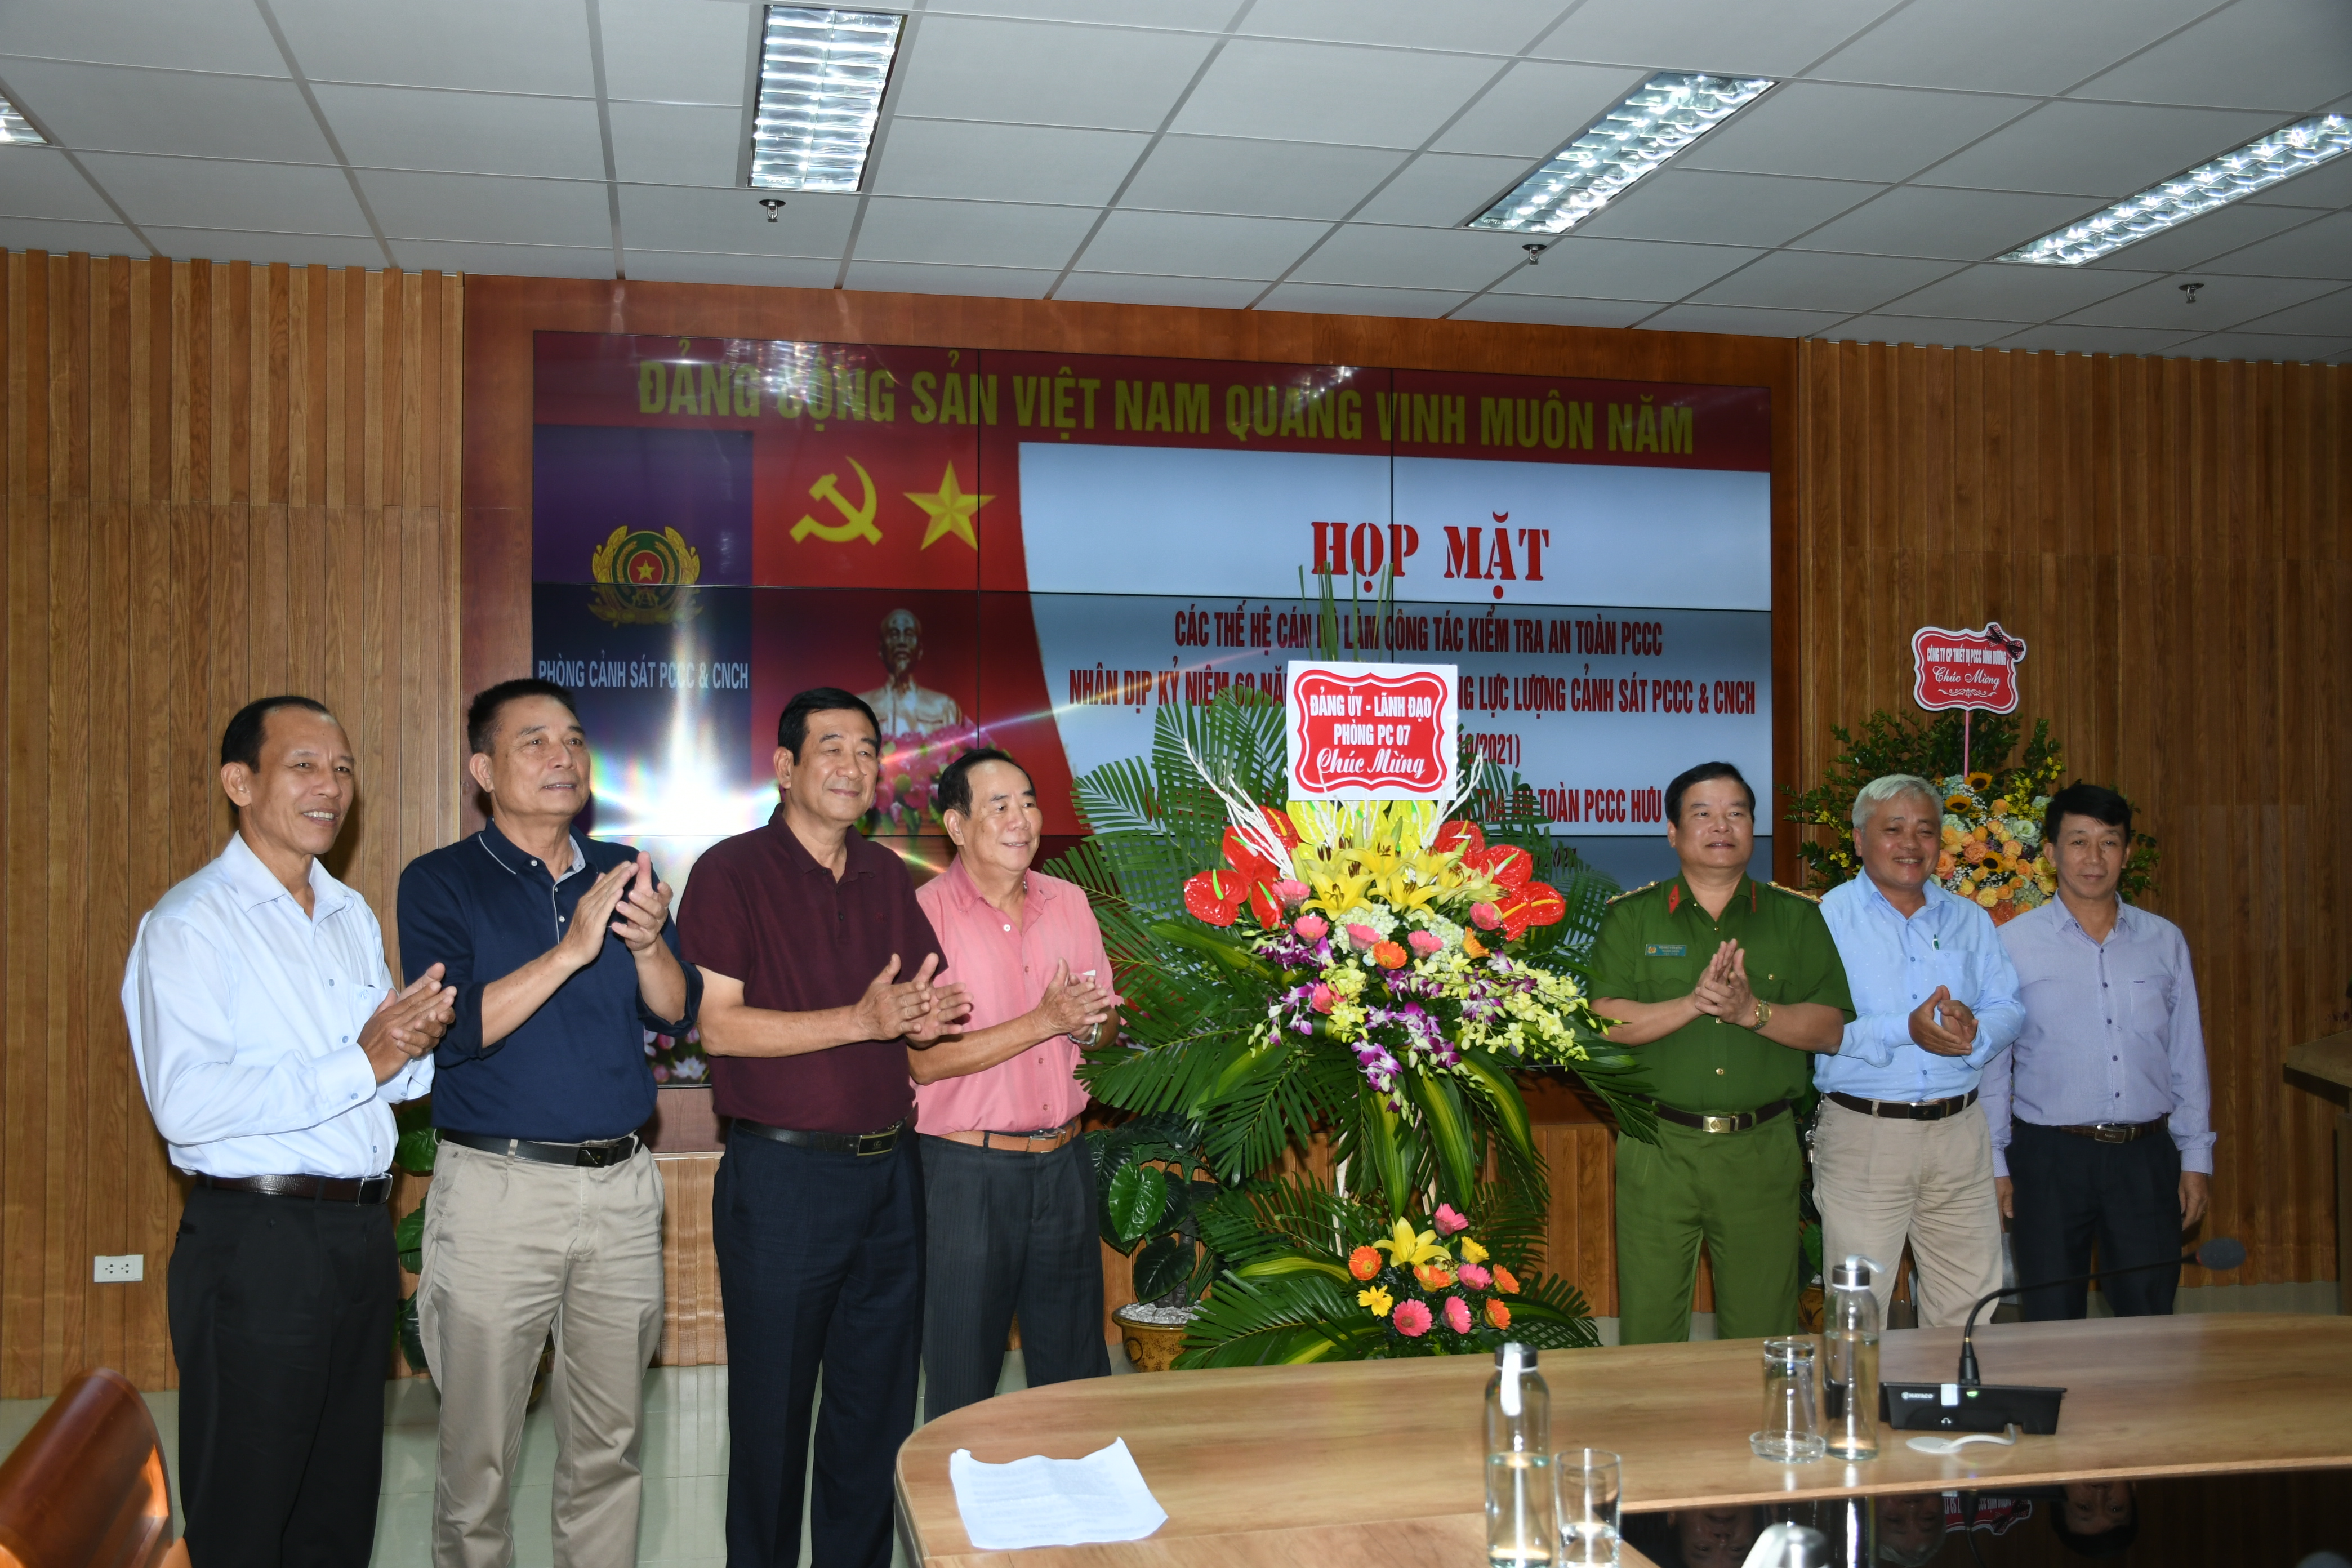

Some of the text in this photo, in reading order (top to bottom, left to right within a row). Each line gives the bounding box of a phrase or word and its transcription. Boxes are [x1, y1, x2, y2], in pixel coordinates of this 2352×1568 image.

[638, 338, 759, 417] ĐẢNG
[911, 350, 997, 425] SẢN
[1014, 366, 1101, 440] VIỆT
[1115, 380, 1210, 434] NAM
[1225, 384, 1362, 442] QUANG
[1376, 392, 1465, 444] VINH
[1481, 390, 1594, 449] MUÔN
[1608, 394, 1693, 455] NĂM
[1311, 511, 1549, 599] HỌP MẶT
[1175, 604, 1209, 646] CÁC
[1214, 600, 1246, 647] THẾ
[1250, 605, 1272, 656] HỆ
[1277, 606, 1312, 648] CÁN
[1385, 609, 1428, 651] CÔNG
[1433, 610, 1463, 652] TÁC
[1468, 605, 1509, 652] KIỂM
[1514, 618, 1544, 653] TRA
[1548, 619, 1571, 654] AN
[1575, 614, 1616, 655] TOÀN
[1621, 622, 1663, 656] PCCC
[538, 649, 749, 689] PHÒNG CẢNH SÁT PCCC & CNCH
[1927, 644, 1940, 662] CÔNG
[1940, 648, 1946, 662] TY
[1953, 643, 1965, 663] THIẾT
[1069, 662, 1118, 705] NHÂN
[1124, 670, 1152, 713] DỊP
[1158, 656, 1180, 706] KỶ
[1479, 673, 1509, 718] LỰC
[1513, 674, 1565, 719] LƯỢNG
[1571, 663, 1614, 712] CẢNH
[1618, 672, 1647, 713] SÁT
[1652, 680, 1692, 714] PCCC
[1699, 683, 1709, 714] &
[1713, 680, 1756, 715] CNCH
[1932, 666, 2000, 690] Chúc Mừng
[1309, 686, 1345, 716] ĐẢNG
[1348, 687, 1363, 716] ỦY
[1374, 692, 1405, 718] LÃNH
[1407, 696, 1432, 722] ĐẠO
[1333, 719, 1411, 746] PHÒNG PC 07
[1316, 747, 1426, 779] Chúc Mừng
[1538, 782, 1579, 823] TOÀN
[1584, 789, 1626, 823] PCCC
[1631, 786, 1662, 823] HƯU
